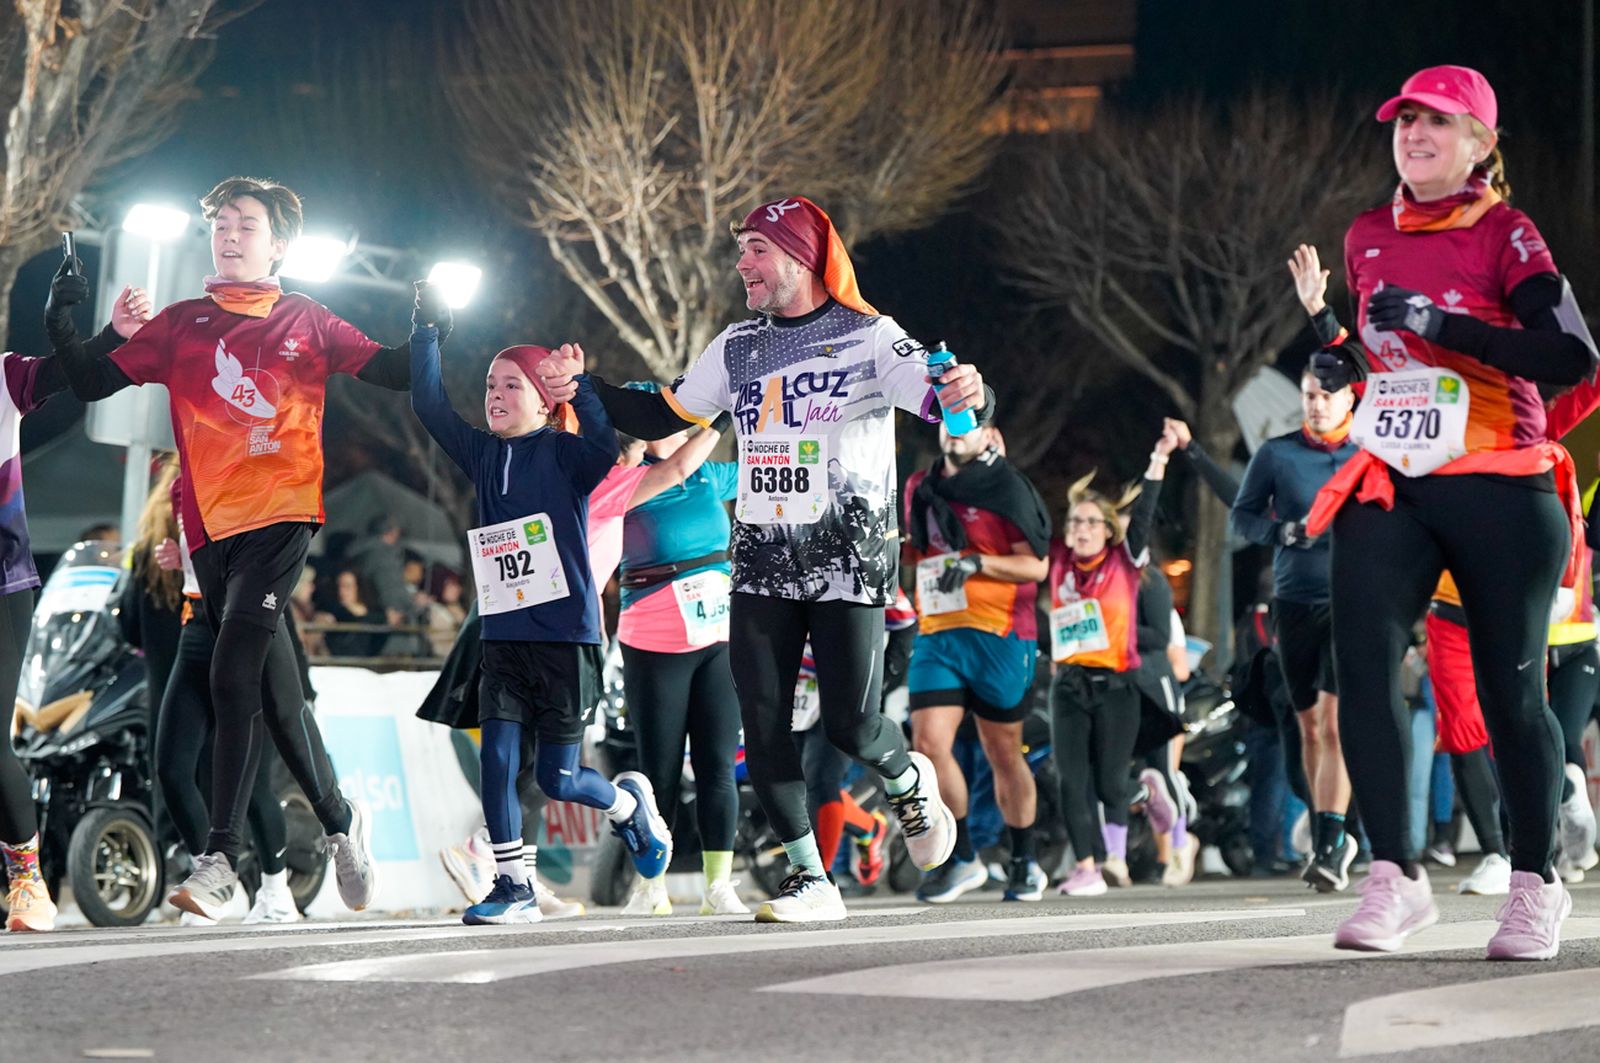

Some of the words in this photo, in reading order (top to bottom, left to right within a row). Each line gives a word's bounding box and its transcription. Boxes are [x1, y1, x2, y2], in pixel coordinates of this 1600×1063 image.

[1379, 340, 1408, 368] 43
[231, 384, 255, 408] 43
[1391, 383, 1418, 395] NOCHE
[1419, 382, 1430, 392] DE
[1374, 397, 1395, 407] SAN
[799, 398, 843, 434] Jaén
[1374, 407, 1442, 440] 5370
[754, 444, 778, 454] NOCHE
[779, 444, 790, 454] DE
[746, 456, 761, 465] SAN
[761, 453, 790, 465] ANTÓN
[750, 466, 810, 494] 6388
[487, 533, 505, 544] NOCHE
[507, 531, 516, 540] DE
[482, 547, 494, 558] SAN
[494, 549, 535, 582] 792
